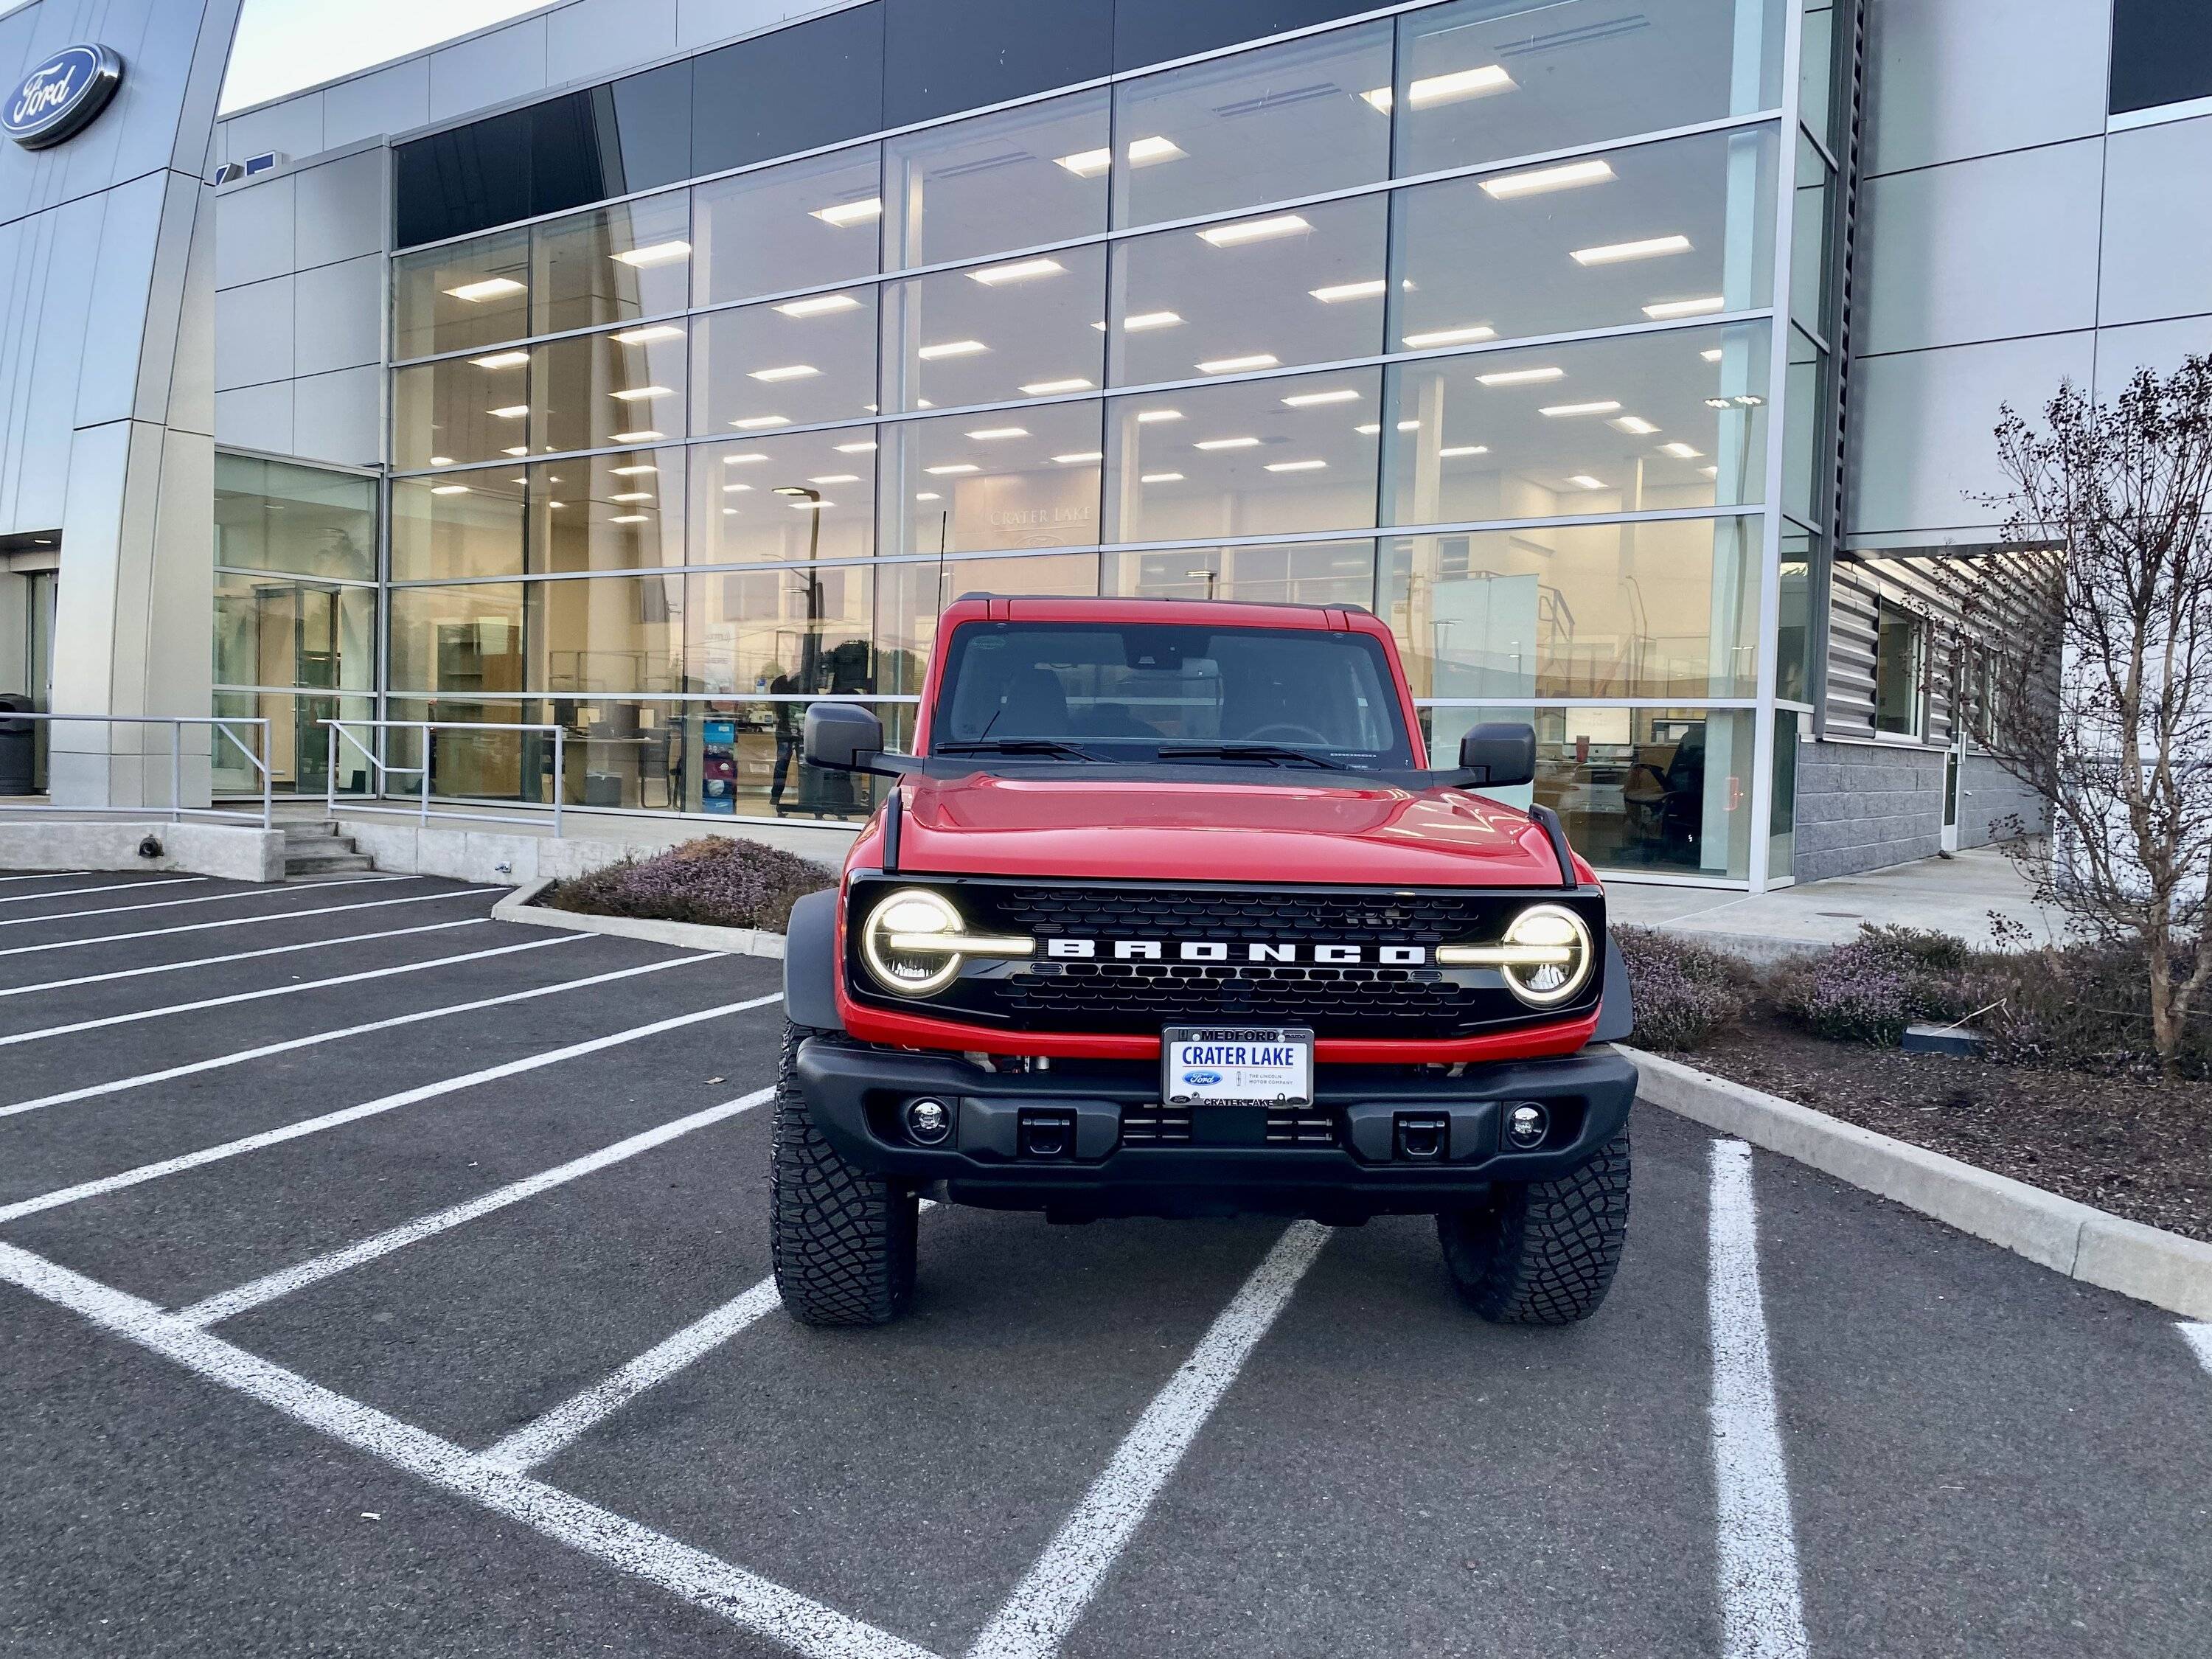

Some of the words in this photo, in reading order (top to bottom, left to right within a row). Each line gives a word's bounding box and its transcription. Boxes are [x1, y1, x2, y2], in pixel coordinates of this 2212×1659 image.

[13, 62, 76, 123] Ford
[990, 508, 1049, 526] CRATER
[1054, 507, 1092, 522] LAKE
[1047, 938, 1426, 964] BRONCO
[1200, 1029, 1277, 1041] MEDFORD
[1182, 1046, 1246, 1065] CRATER
[1251, 1047, 1294, 1066] LAKE
[1189, 1072, 1215, 1084] Ford
[1203, 1098, 1243, 1107] CRATER
[1248, 1099, 1274, 1107] LAKE
